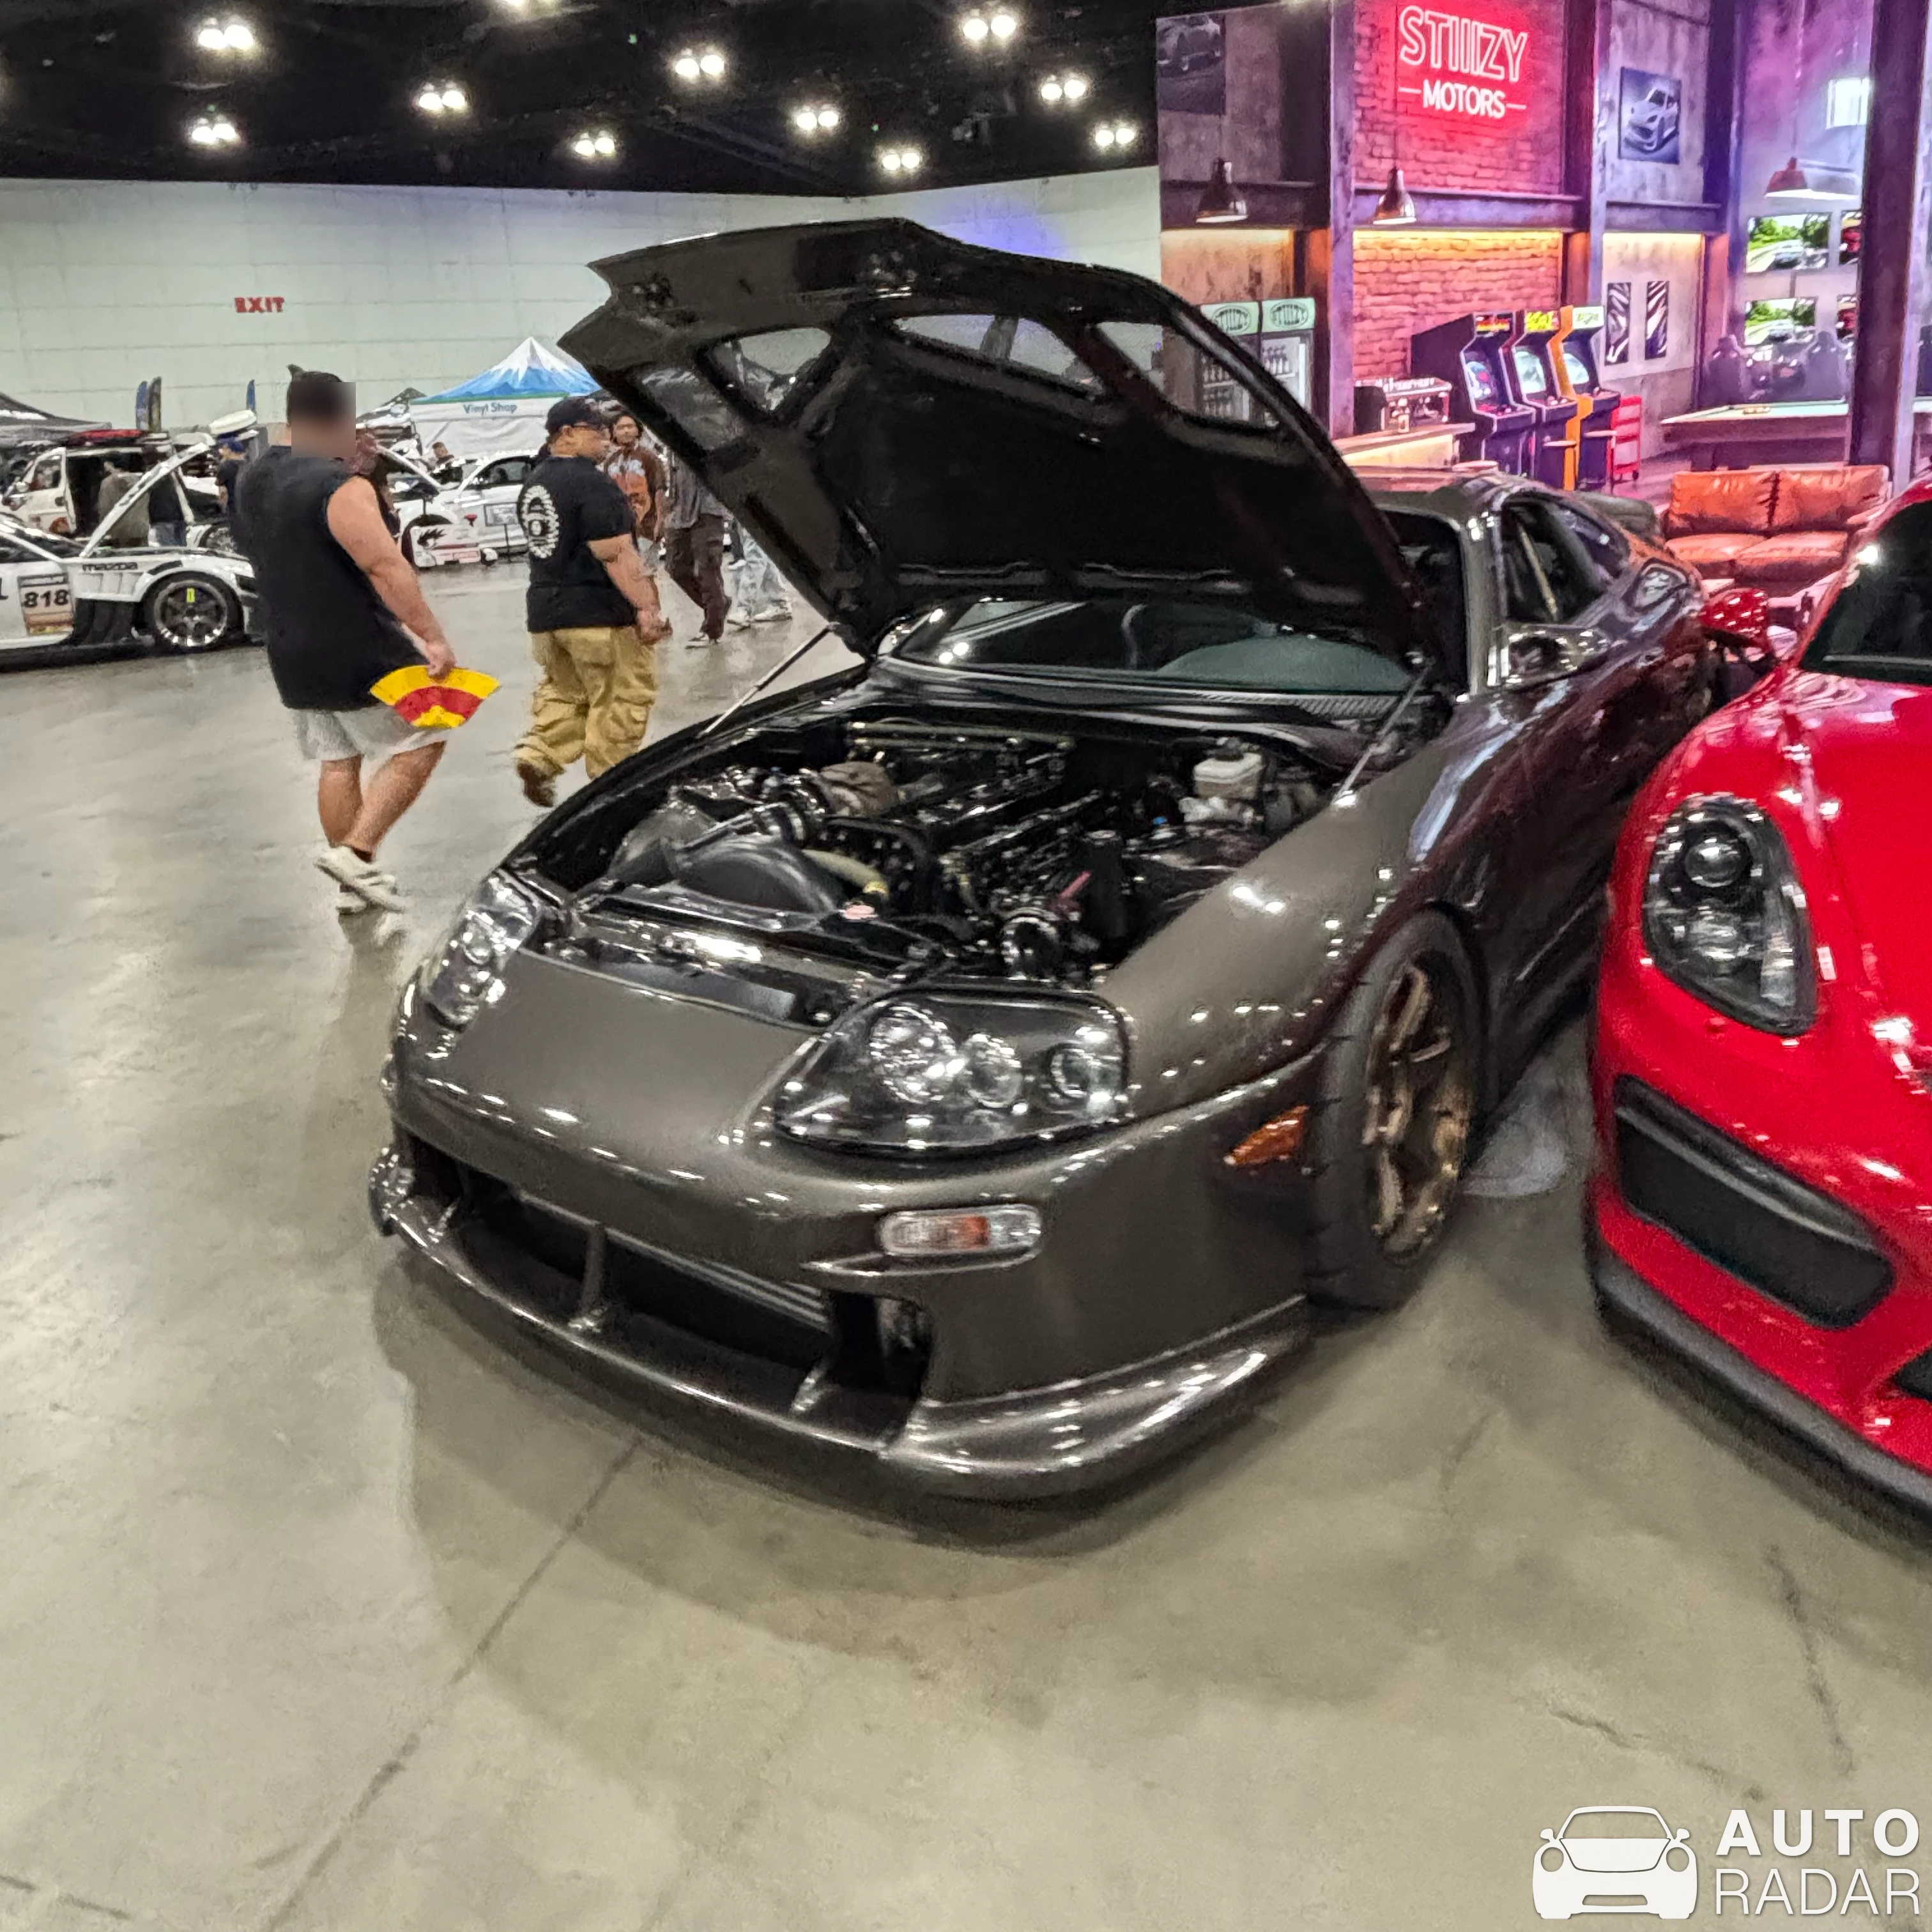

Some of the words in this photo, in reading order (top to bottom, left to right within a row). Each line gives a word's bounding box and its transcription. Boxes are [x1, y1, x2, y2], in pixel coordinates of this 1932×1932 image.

[1399, 5, 1528, 83] STIIIZY
[1422, 79, 1506, 119] MOTORS
[234, 296, 285, 313] EXIT
[463, 403, 489, 417] Vinyl
[491, 402, 517, 414] Shop
[22, 589, 69, 608] 818
